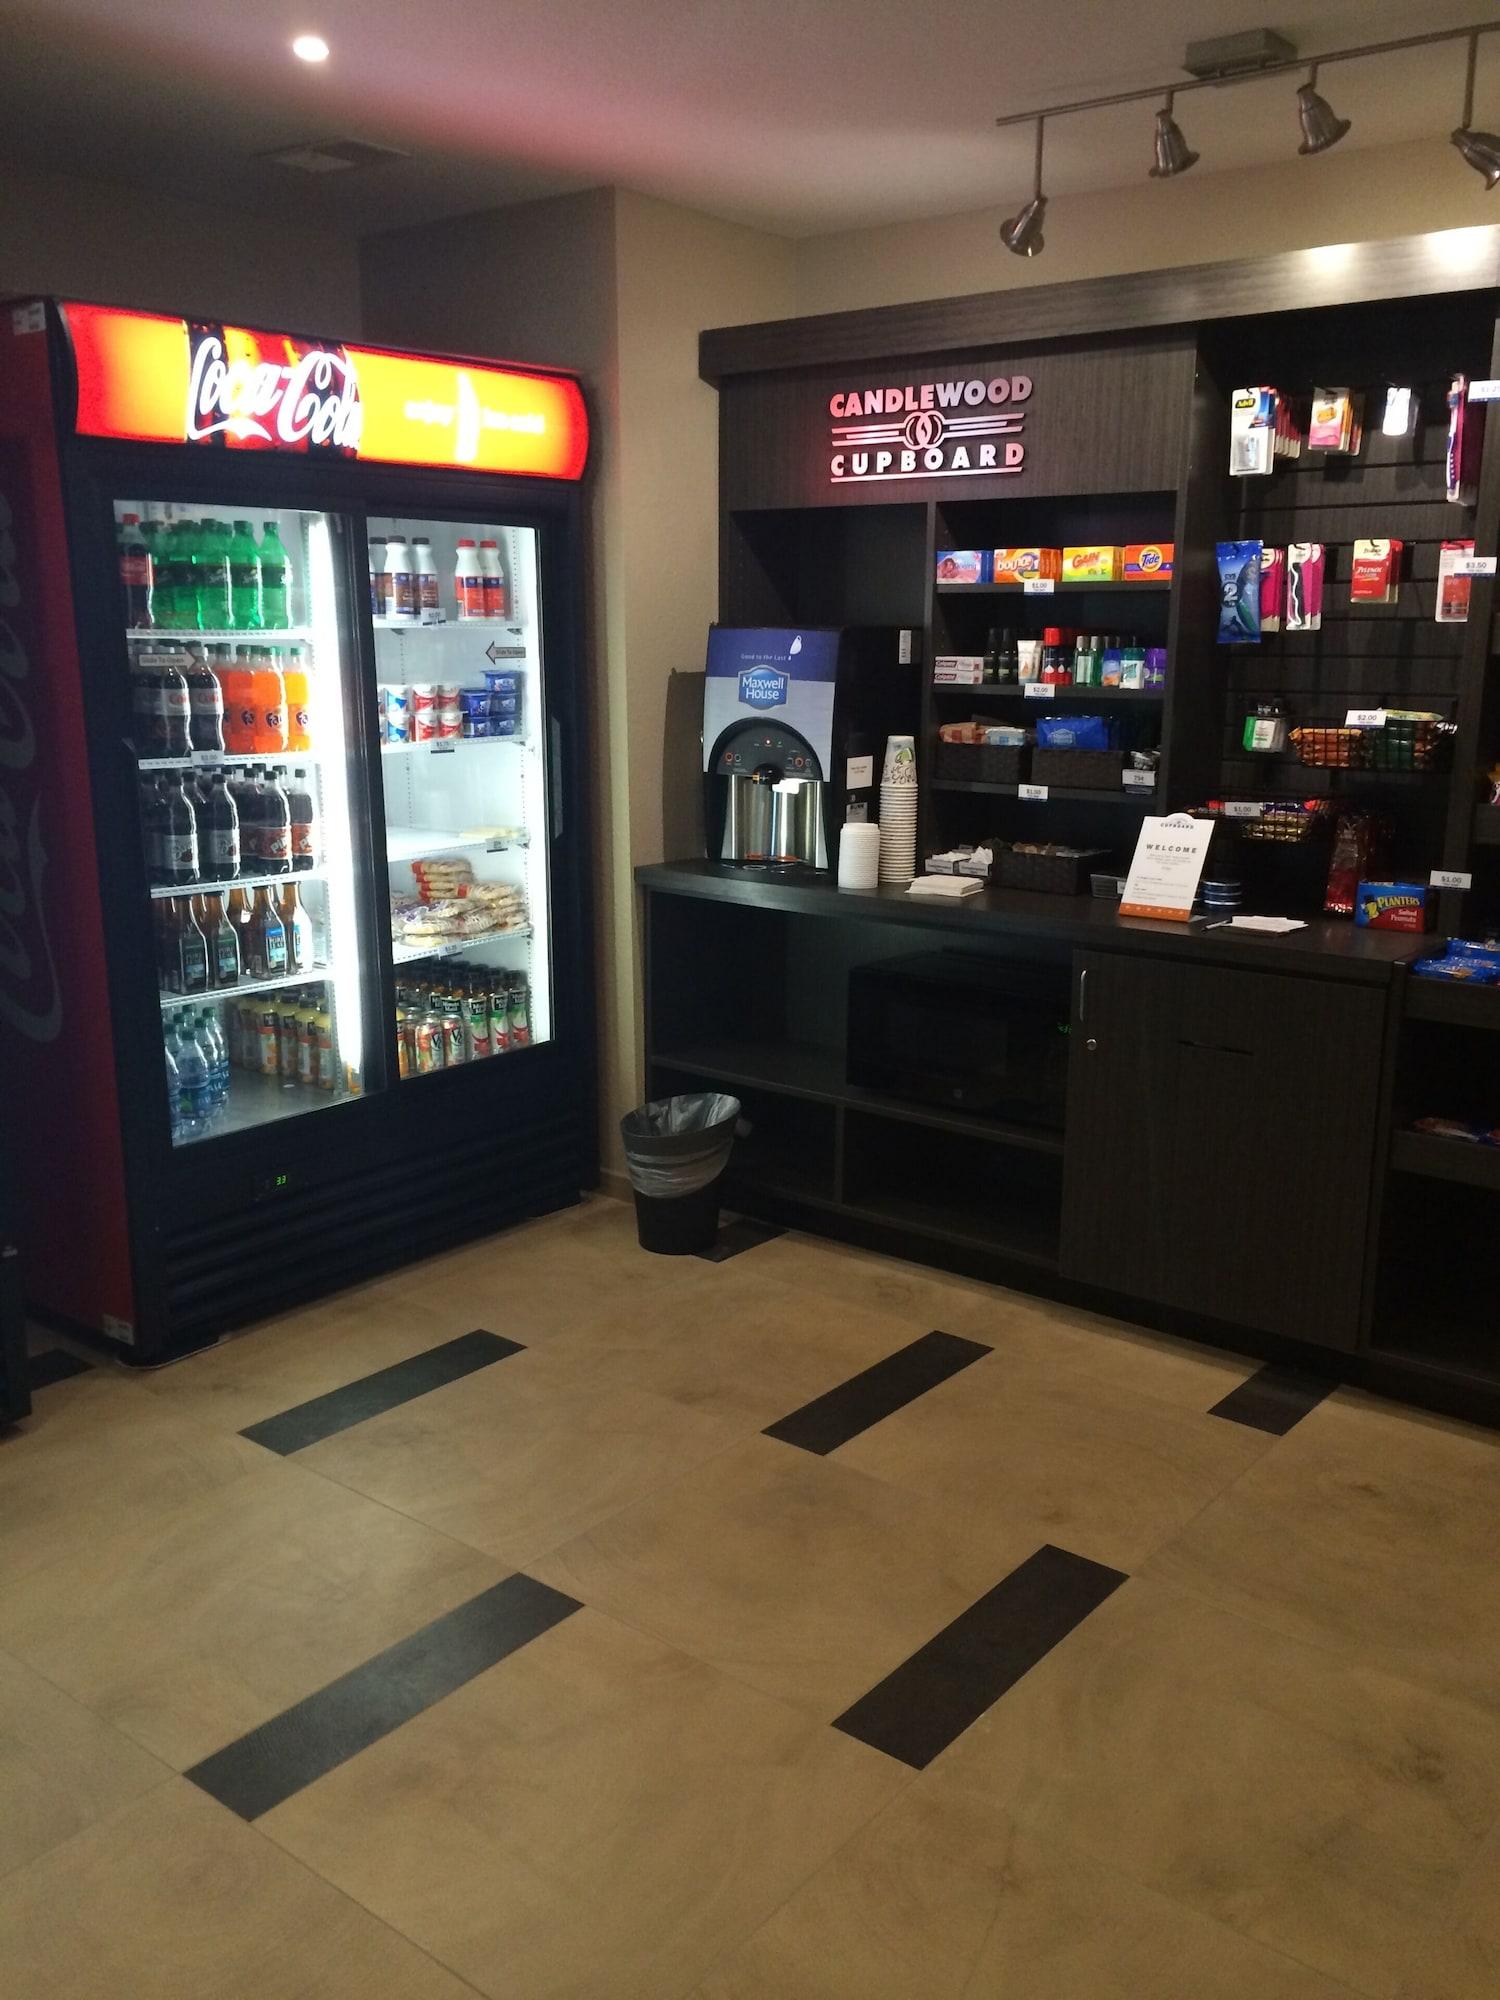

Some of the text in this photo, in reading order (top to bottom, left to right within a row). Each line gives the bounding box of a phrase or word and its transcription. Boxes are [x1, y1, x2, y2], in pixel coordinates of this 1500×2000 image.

[829, 375, 1033, 418] CANDLEWOOD
[830, 442, 1025, 477] CUPBOARD
[1141, 553, 1160, 567] Tide
[742, 676, 784, 690] Maxwell
[745, 688, 780, 700] House
[1160, 822, 1194, 830] CUPBOARD
[1146, 843, 1198, 854] WELCOME
[1377, 896, 1420, 909] PLANTERS
[1390, 914, 1417, 923] Peanuts
[1398, 908, 1418, 917] Salted
[276, 1175, 287, 1186] 33
